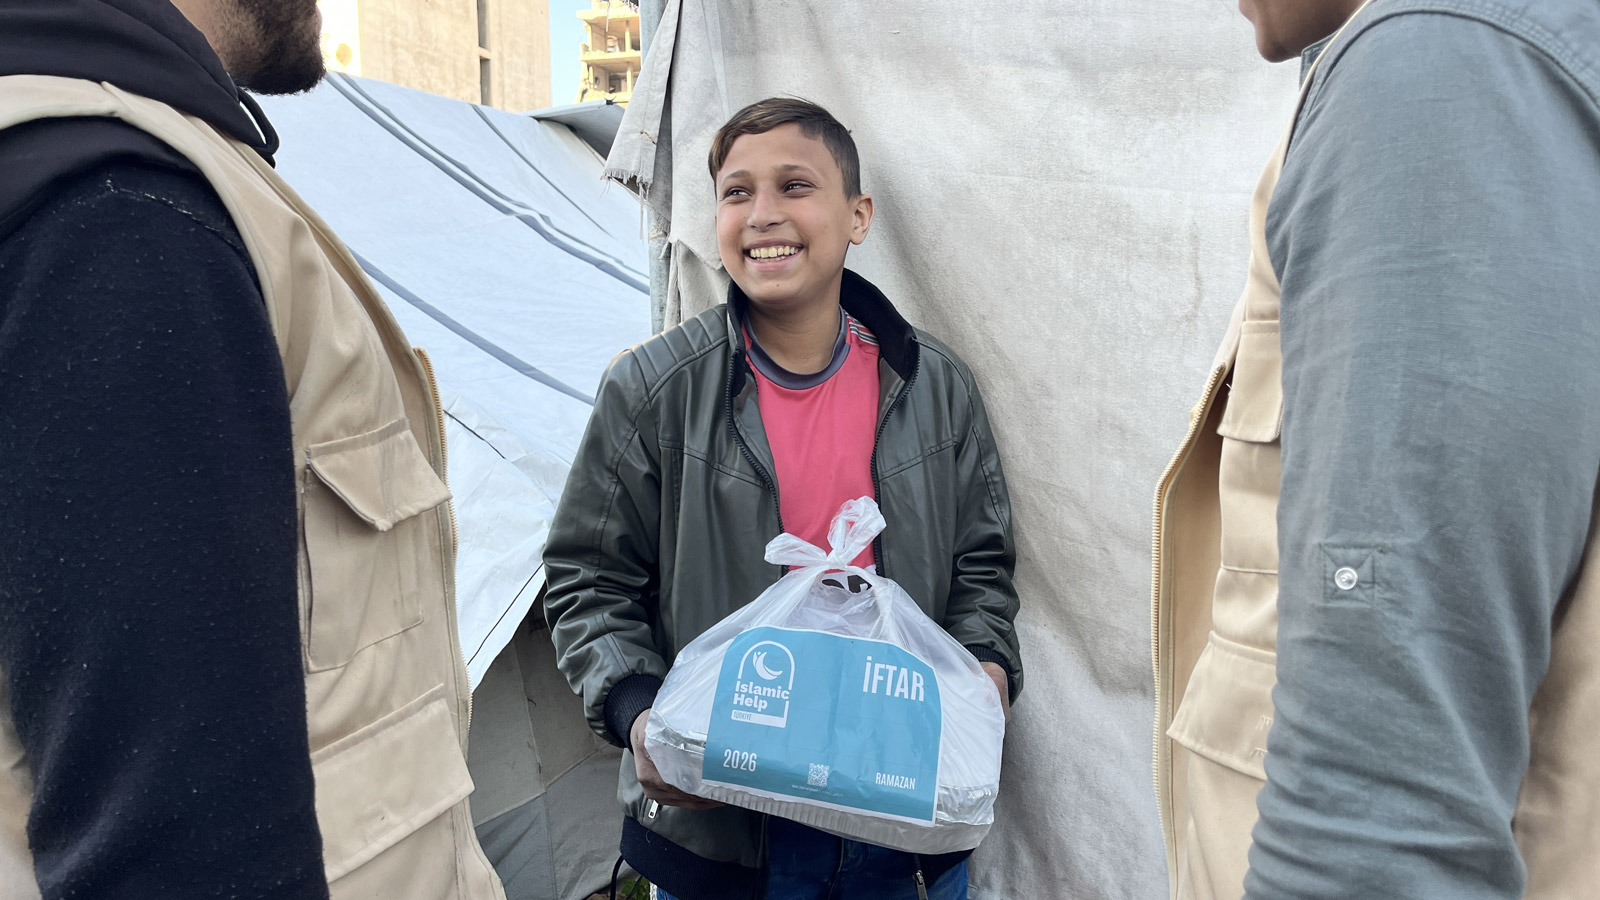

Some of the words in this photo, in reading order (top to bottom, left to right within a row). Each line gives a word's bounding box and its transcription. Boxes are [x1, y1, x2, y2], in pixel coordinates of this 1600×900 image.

[863, 656, 924, 701] İFTAR
[736, 681, 789, 699] Islamic
[733, 693, 768, 712] Help
[723, 749, 757, 771] 2026
[875, 772, 916, 790] RAMAZAN
